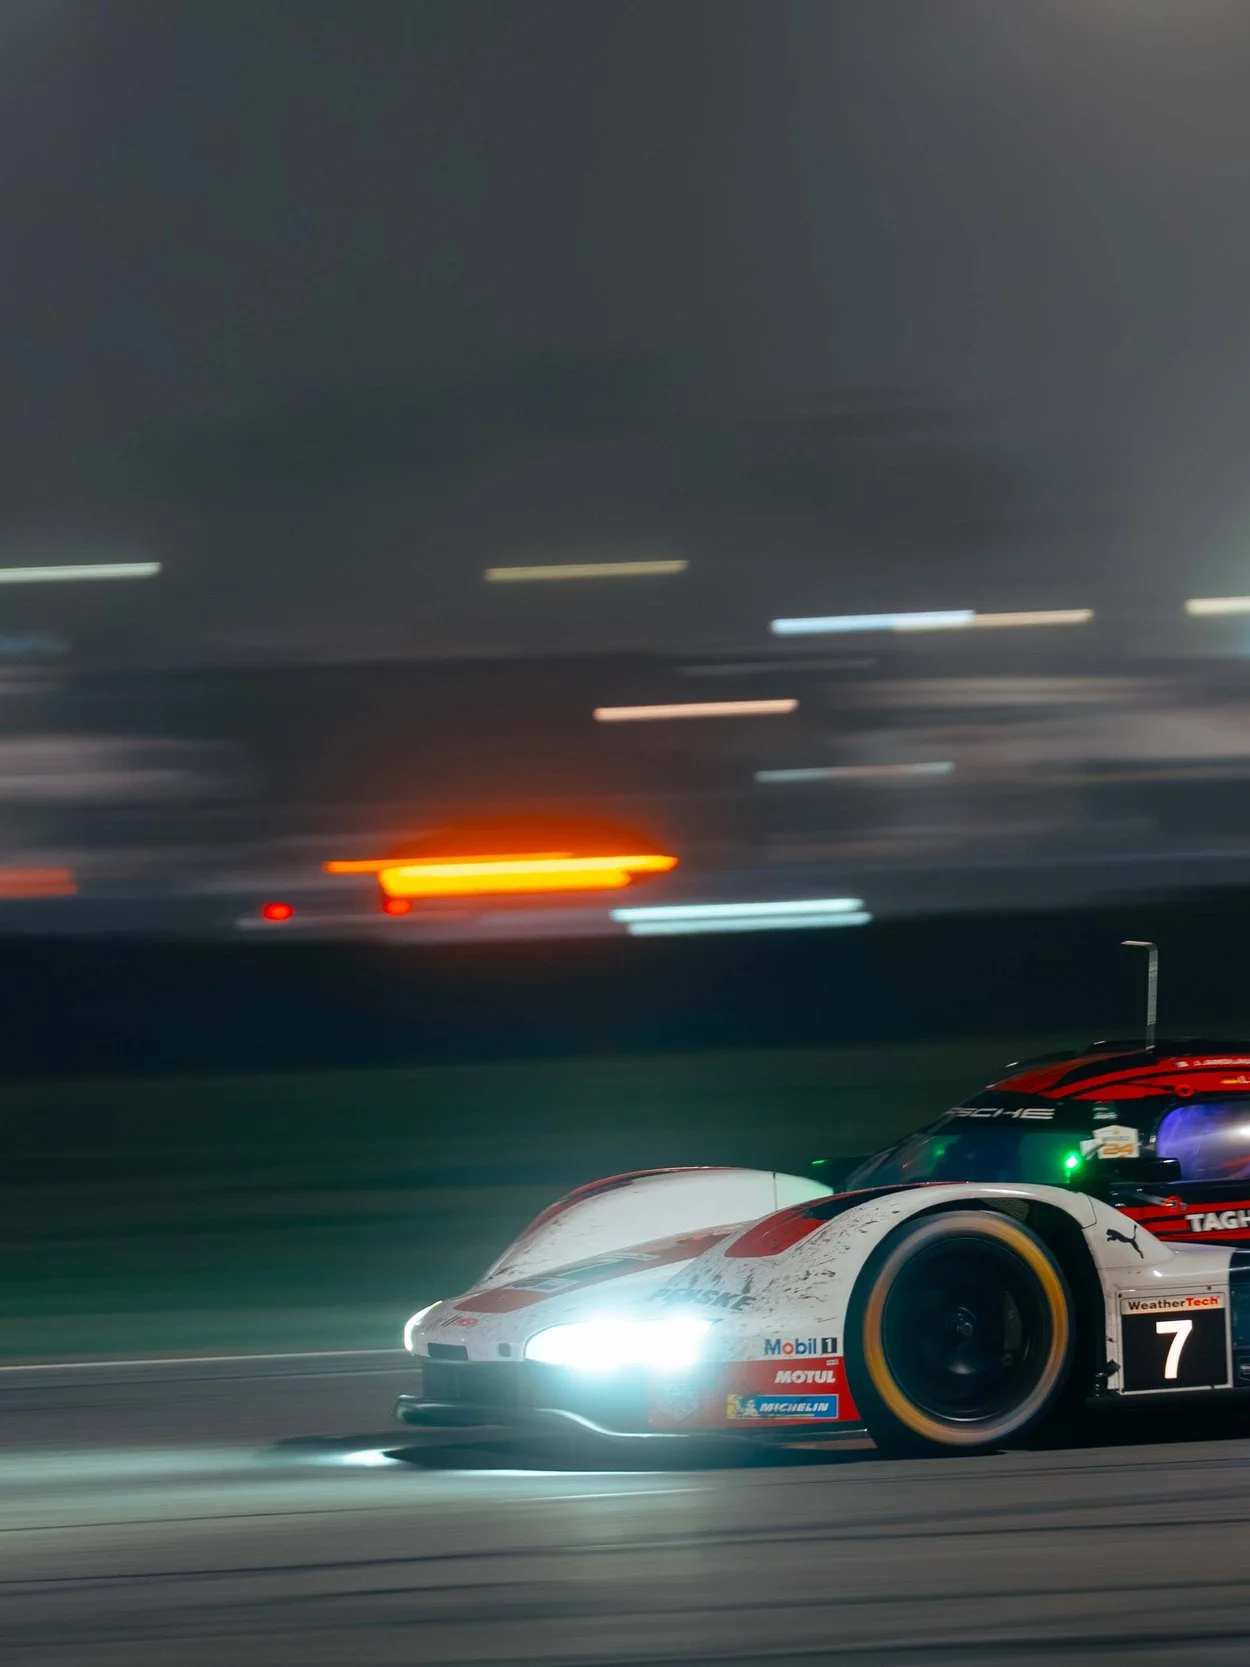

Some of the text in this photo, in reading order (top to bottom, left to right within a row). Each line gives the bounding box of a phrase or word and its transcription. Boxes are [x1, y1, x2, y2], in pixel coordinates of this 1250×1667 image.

[1128, 1296, 1219, 1311] WeatherTech
[764, 1337, 836, 1355] Mobil 1
[1156, 1320, 1193, 1379] 7
[774, 1370, 836, 1384] MOTUL
[759, 1402, 829, 1412] MICHELIN
